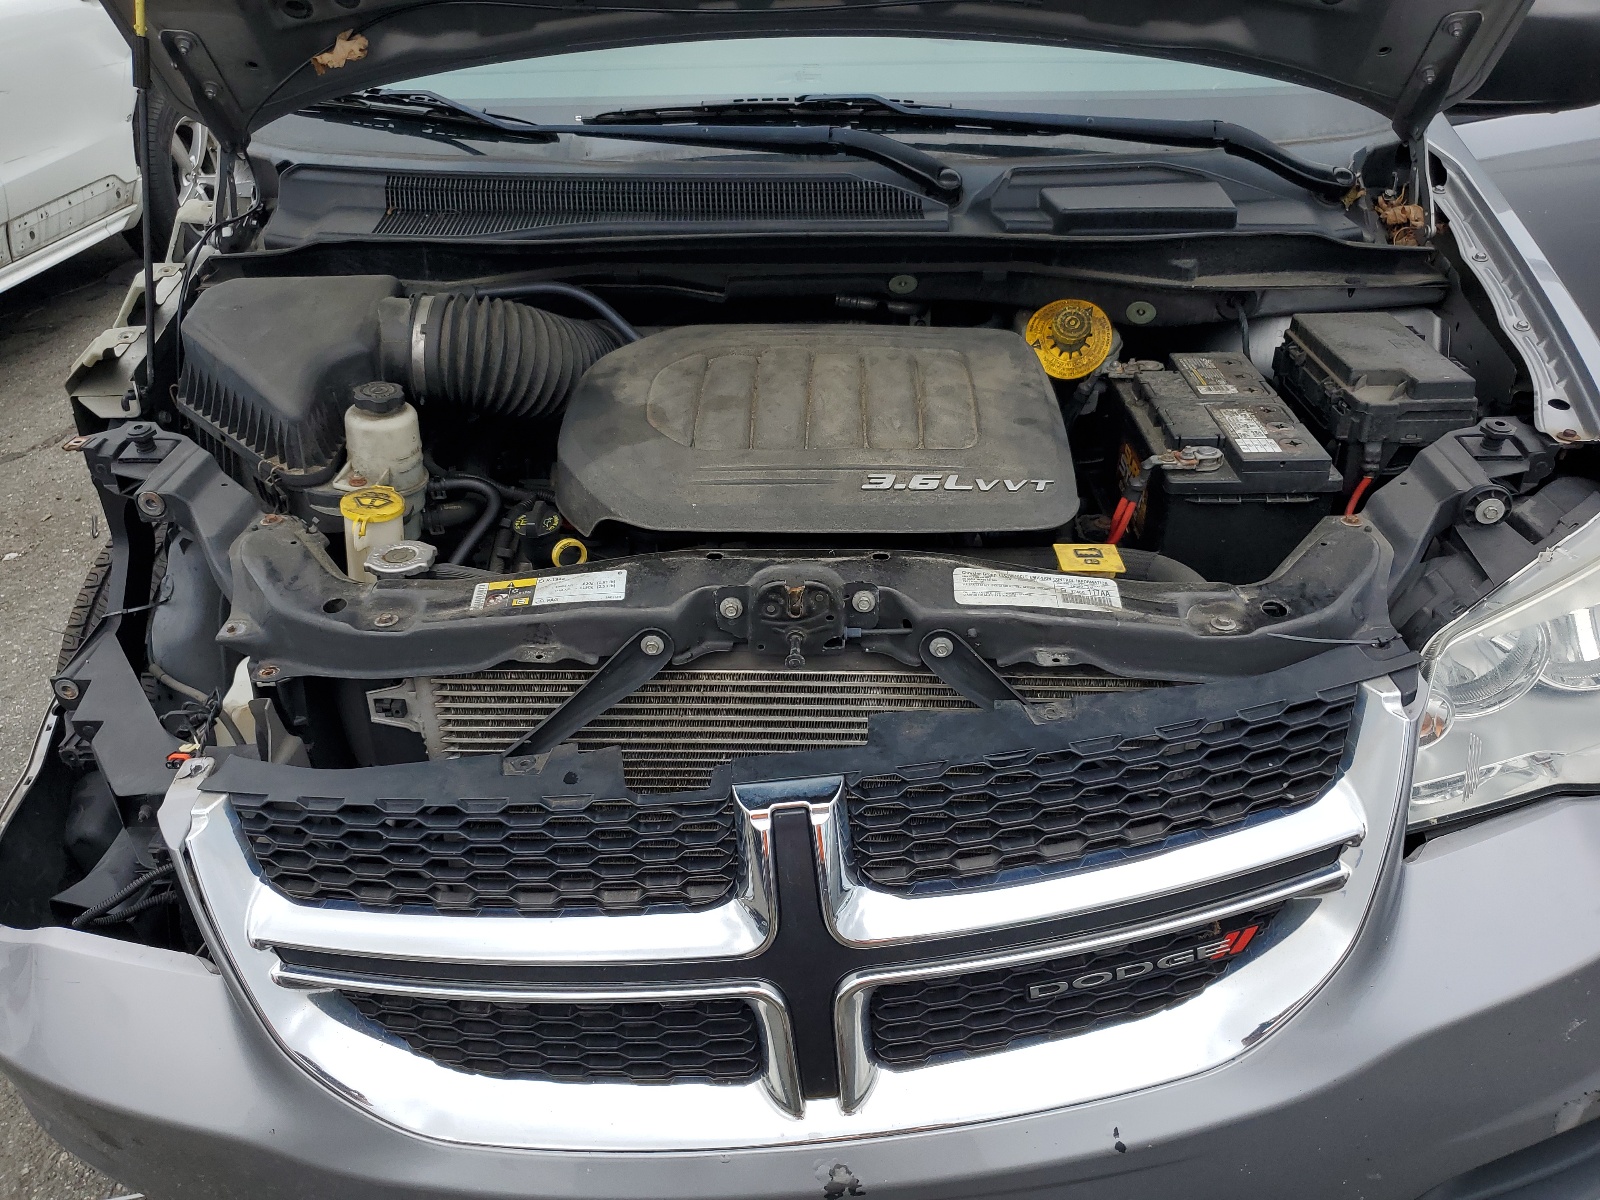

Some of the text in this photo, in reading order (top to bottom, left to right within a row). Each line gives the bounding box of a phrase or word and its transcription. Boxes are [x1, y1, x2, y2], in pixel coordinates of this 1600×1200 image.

[861, 473, 1055, 492] 3.6L VVT
[1029, 938, 1231, 999] DODGE
